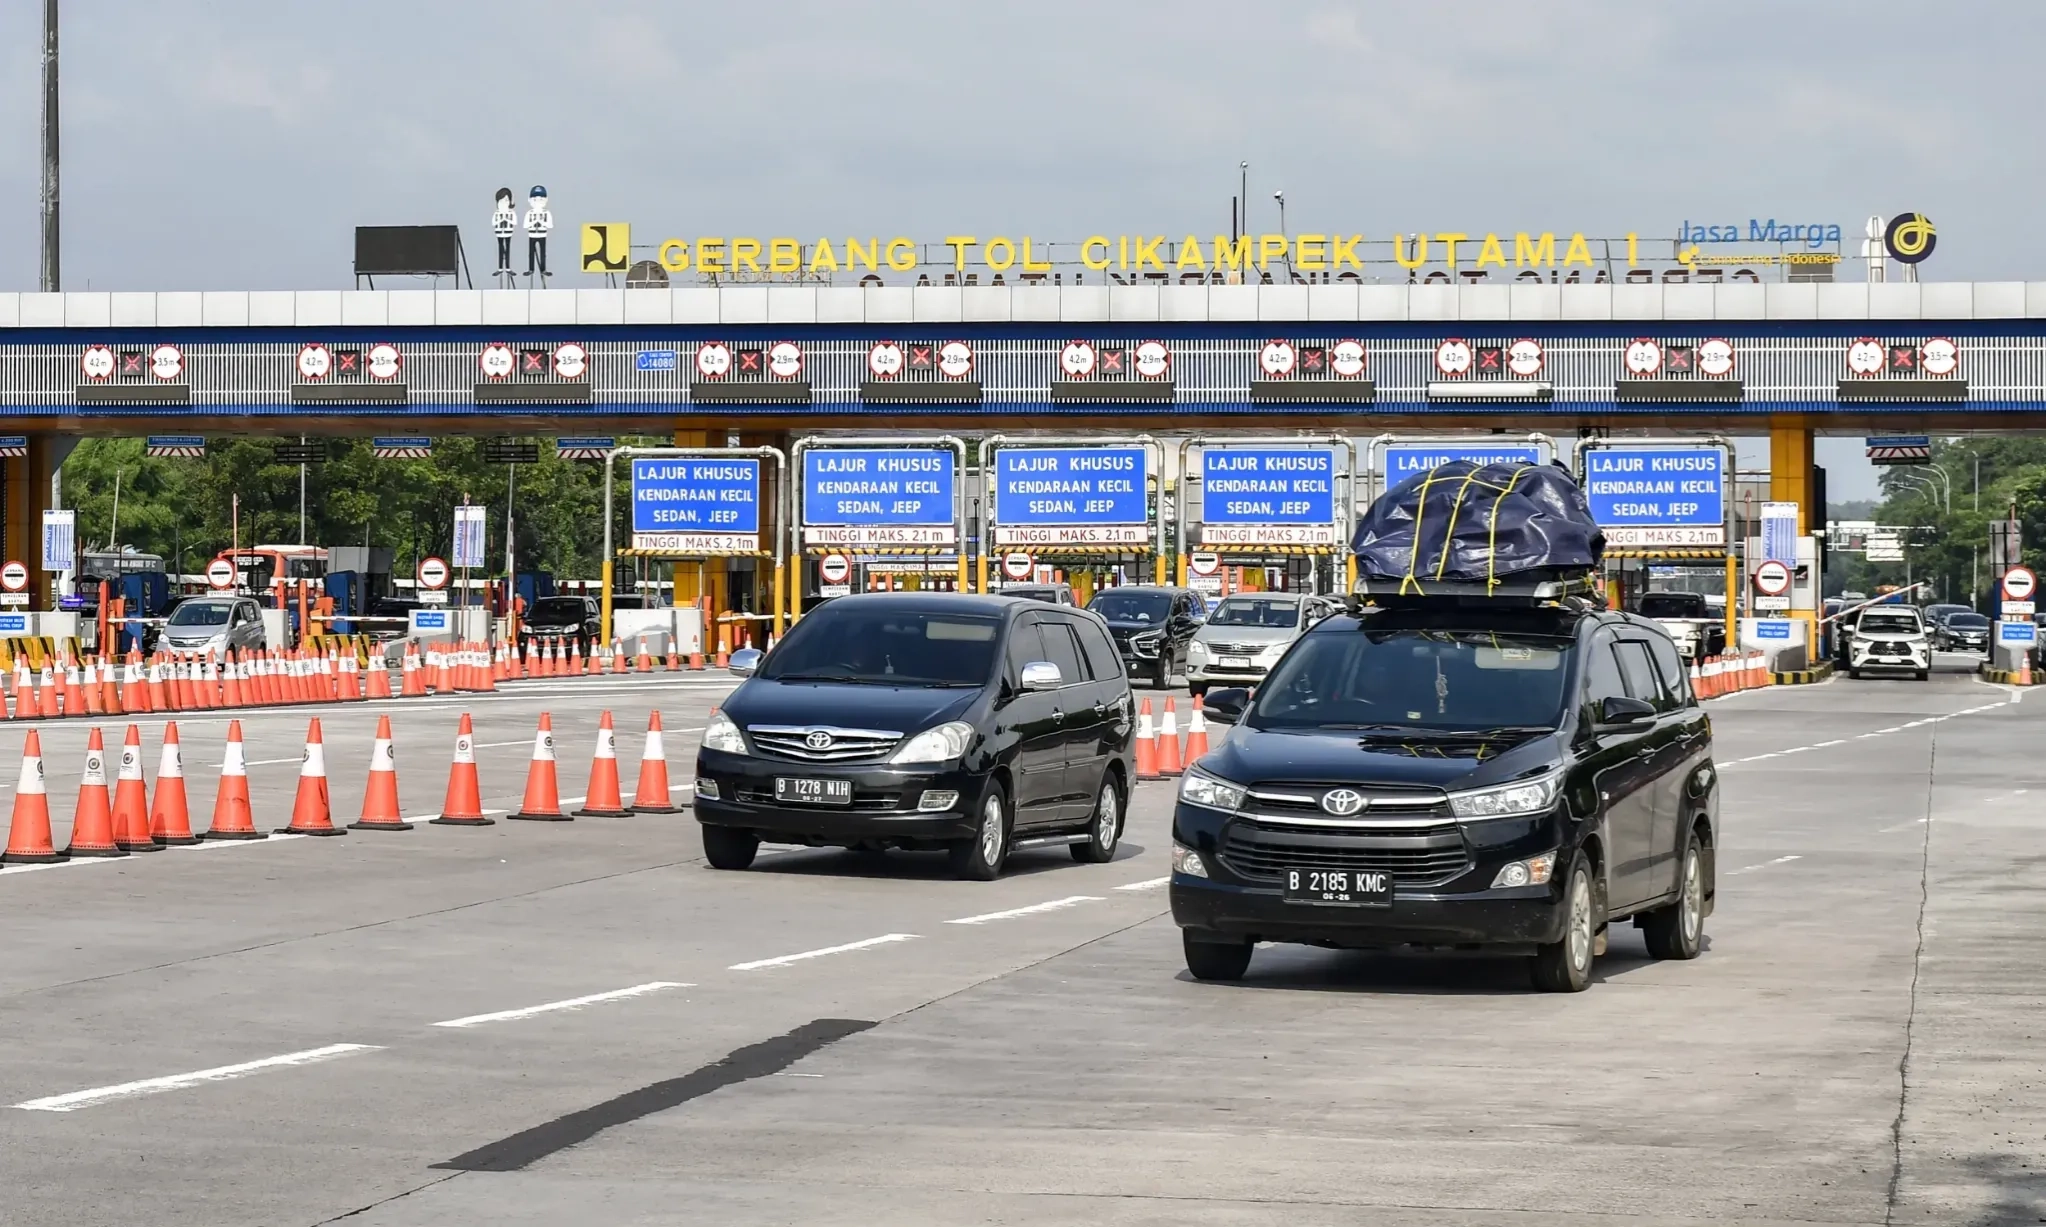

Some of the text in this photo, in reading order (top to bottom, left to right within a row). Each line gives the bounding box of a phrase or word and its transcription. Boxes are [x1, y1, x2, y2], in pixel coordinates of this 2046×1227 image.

[1682, 218, 1841, 249] Jasa Marga
[659, 232, 1638, 274] GERBANG TOL CIKAMPEK UTAMA 1
[649, 358, 674, 368] 14080
[817, 458, 942, 472] LAJUR KHUSUS
[1009, 457, 1134, 471] LAJUR KHUSUS
[1208, 457, 1328, 471] LAJUR KHUSUS
[1593, 457, 1716, 472] LAJUR KHUSUS
[638, 467, 753, 480] LAJUR KHUSUS
[817, 481, 941, 494] KENDARAAN KECIL
[1009, 480, 1134, 494] KENDARAAN KECIL
[1207, 480, 1329, 493] KENDARAAN KECIL
[1592, 480, 1717, 494] KENDARAAN KECIL
[638, 489, 753, 502] KENDARAAN KECIL
[837, 500, 921, 515] SEDAN, JEEP
[1028, 500, 1115, 515] SEDAN, JEEP
[1227, 502, 1311, 516] SEDAN, JEEP
[1613, 502, 1698, 518] SEDAN, JEEP
[653, 510, 738, 524] SEDAN, JEEP
[638, 536, 679, 548] TINGGI
[685, 537, 723, 549] MAKS.
[817, 530, 861, 541] TINGGI
[868, 530, 908, 541] MAKS.
[1007, 530, 1051, 541] TINGGI
[1059, 530, 1099, 541] MAKS.
[1208, 530, 1251, 542] TINGGI
[1256, 530, 1293, 542] MAKS
[1603, 531, 1638, 542] NGGI
[1645, 531, 1683, 542] MAKS
[778, 779, 849, 796] B 1278 NIH
[1289, 871, 1387, 893] B 2185 KMC
